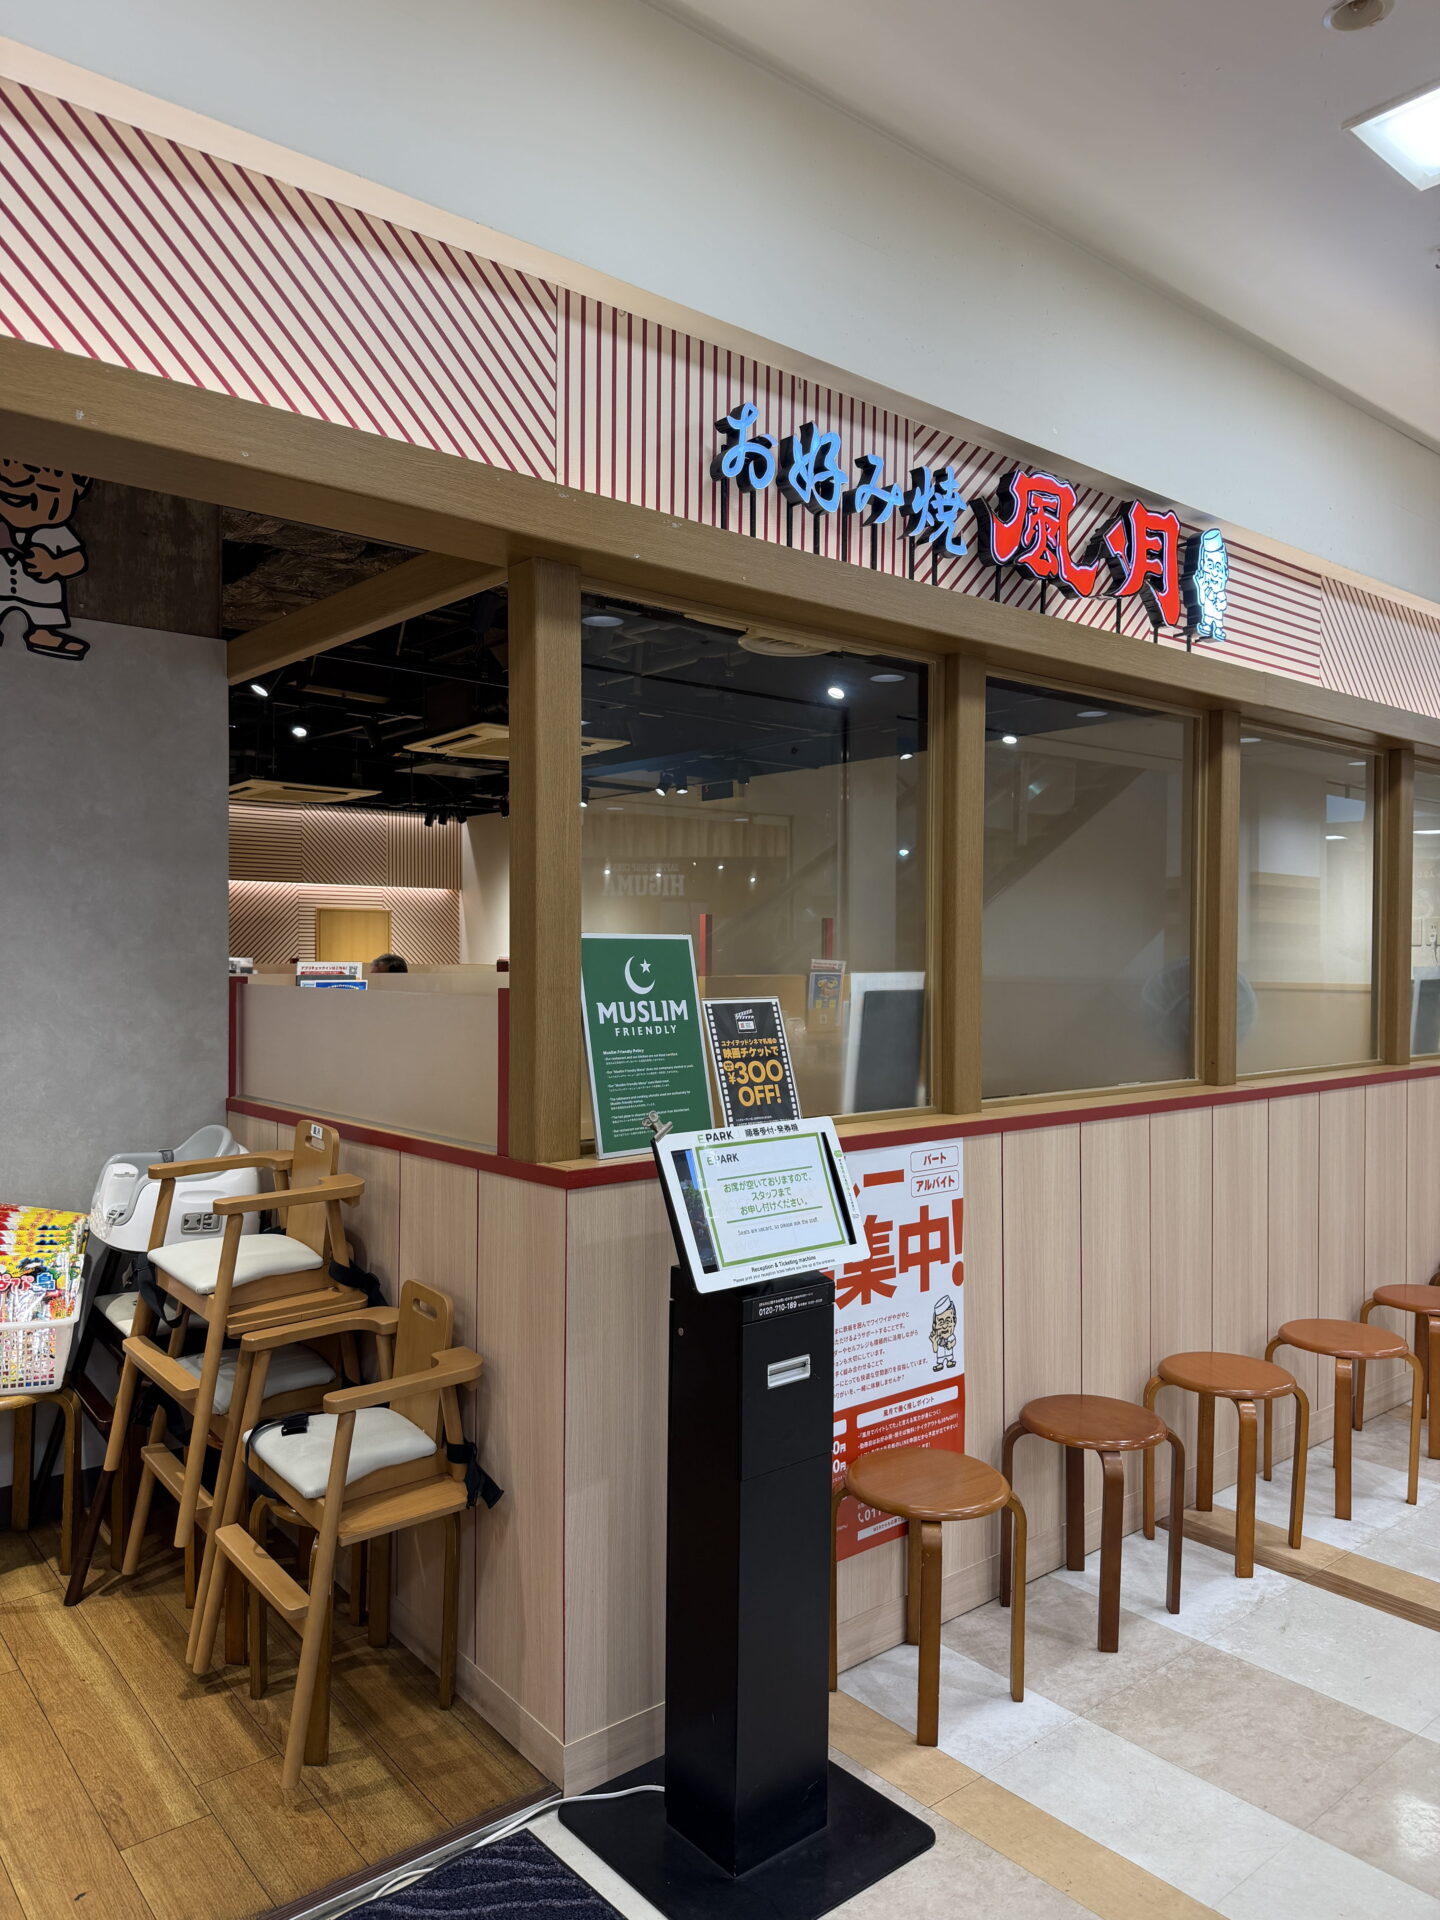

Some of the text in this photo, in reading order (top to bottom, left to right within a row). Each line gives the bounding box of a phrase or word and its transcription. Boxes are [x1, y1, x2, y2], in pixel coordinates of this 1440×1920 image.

[721, 402, 968, 556] お好み焼
[596, 1000, 689, 1025] MUSLIM
[615, 1024, 678, 1037] FRIENDLY
[722, 1046, 779, 1059] 映画チケットで
[738, 1084, 783, 1107] OFF!
[697, 1131, 734, 1144] EPARK
[922, 1152, 947, 1166] パート
[723, 1172, 813, 1194] お席が空いておりますので、
[854, 1169, 905, 1198] ー
[915, 1175, 955, 1193] アルバイト
[752, 1186, 792, 1202] スタッフまで
[740, 1198, 808, 1216] お申し付けください。
[822, 1198, 964, 1310] 集中!
[751, 1263, 774, 1273] Reception
[779, 1259, 799, 1268] Ticketing
[799, 1255, 817, 1263] machine
[758, 1301, 797, 1316] 0120-710-189
